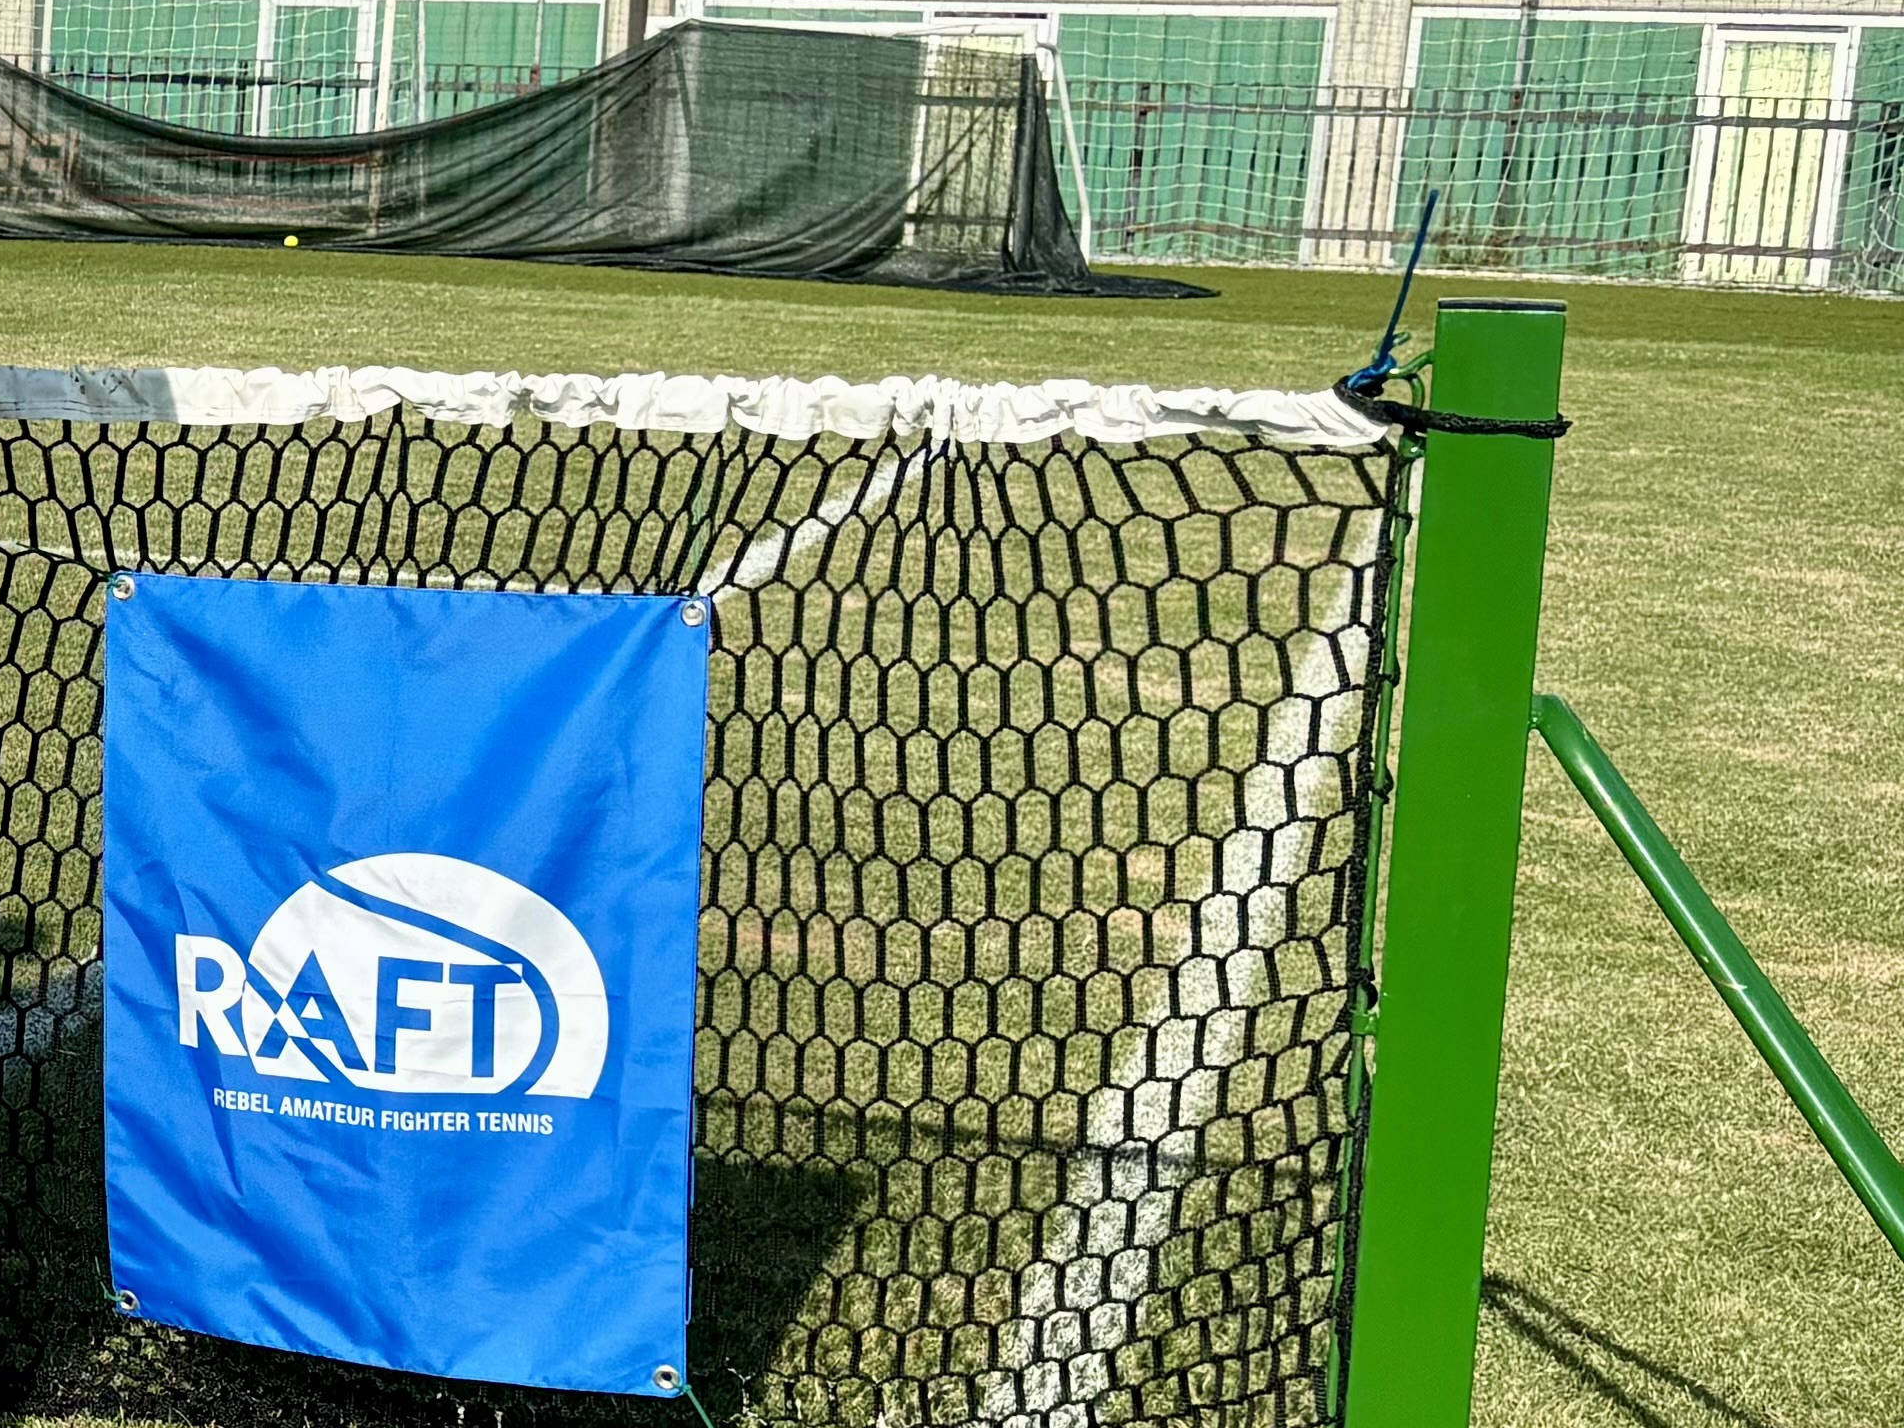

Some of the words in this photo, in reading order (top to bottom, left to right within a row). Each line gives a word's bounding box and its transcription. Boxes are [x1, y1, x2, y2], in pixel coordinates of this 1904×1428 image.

[175, 933, 524, 1079] RAFT
[213, 1087, 274, 1115] REBEL
[279, 1096, 376, 1129] AMATEUR
[380, 1110, 471, 1133] FIGHTER
[476, 1113, 554, 1136] TENNIS
